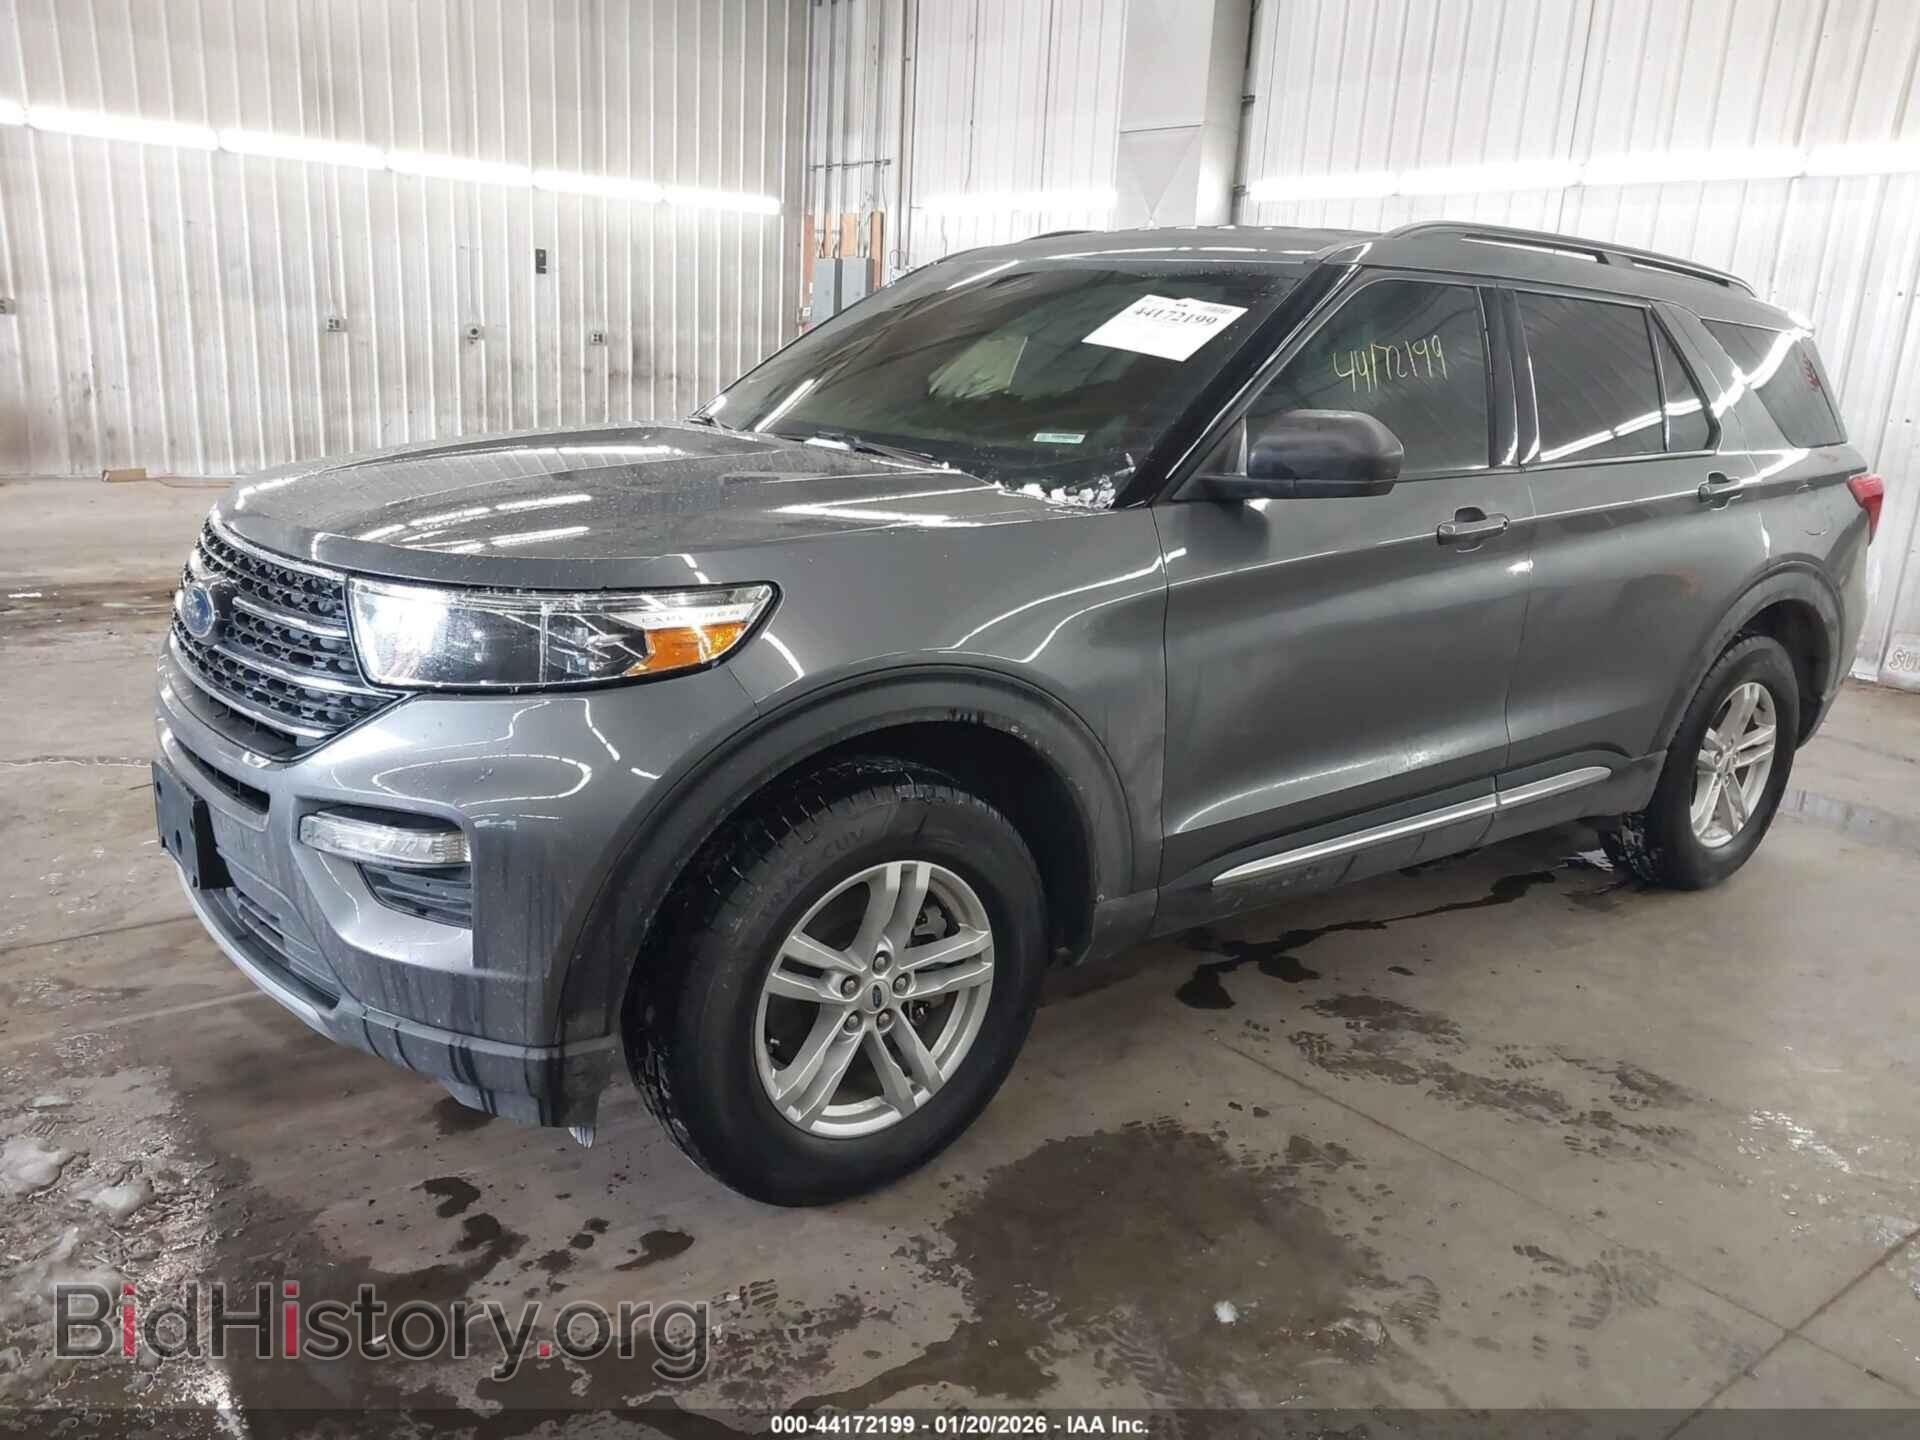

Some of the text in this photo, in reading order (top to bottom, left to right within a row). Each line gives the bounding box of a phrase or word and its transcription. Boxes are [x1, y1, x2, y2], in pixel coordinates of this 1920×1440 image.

[1135, 307, 1218, 326] 44172199
[1333, 334, 1448, 392] 44172199
[641, 609, 740, 624] EXPLRER
